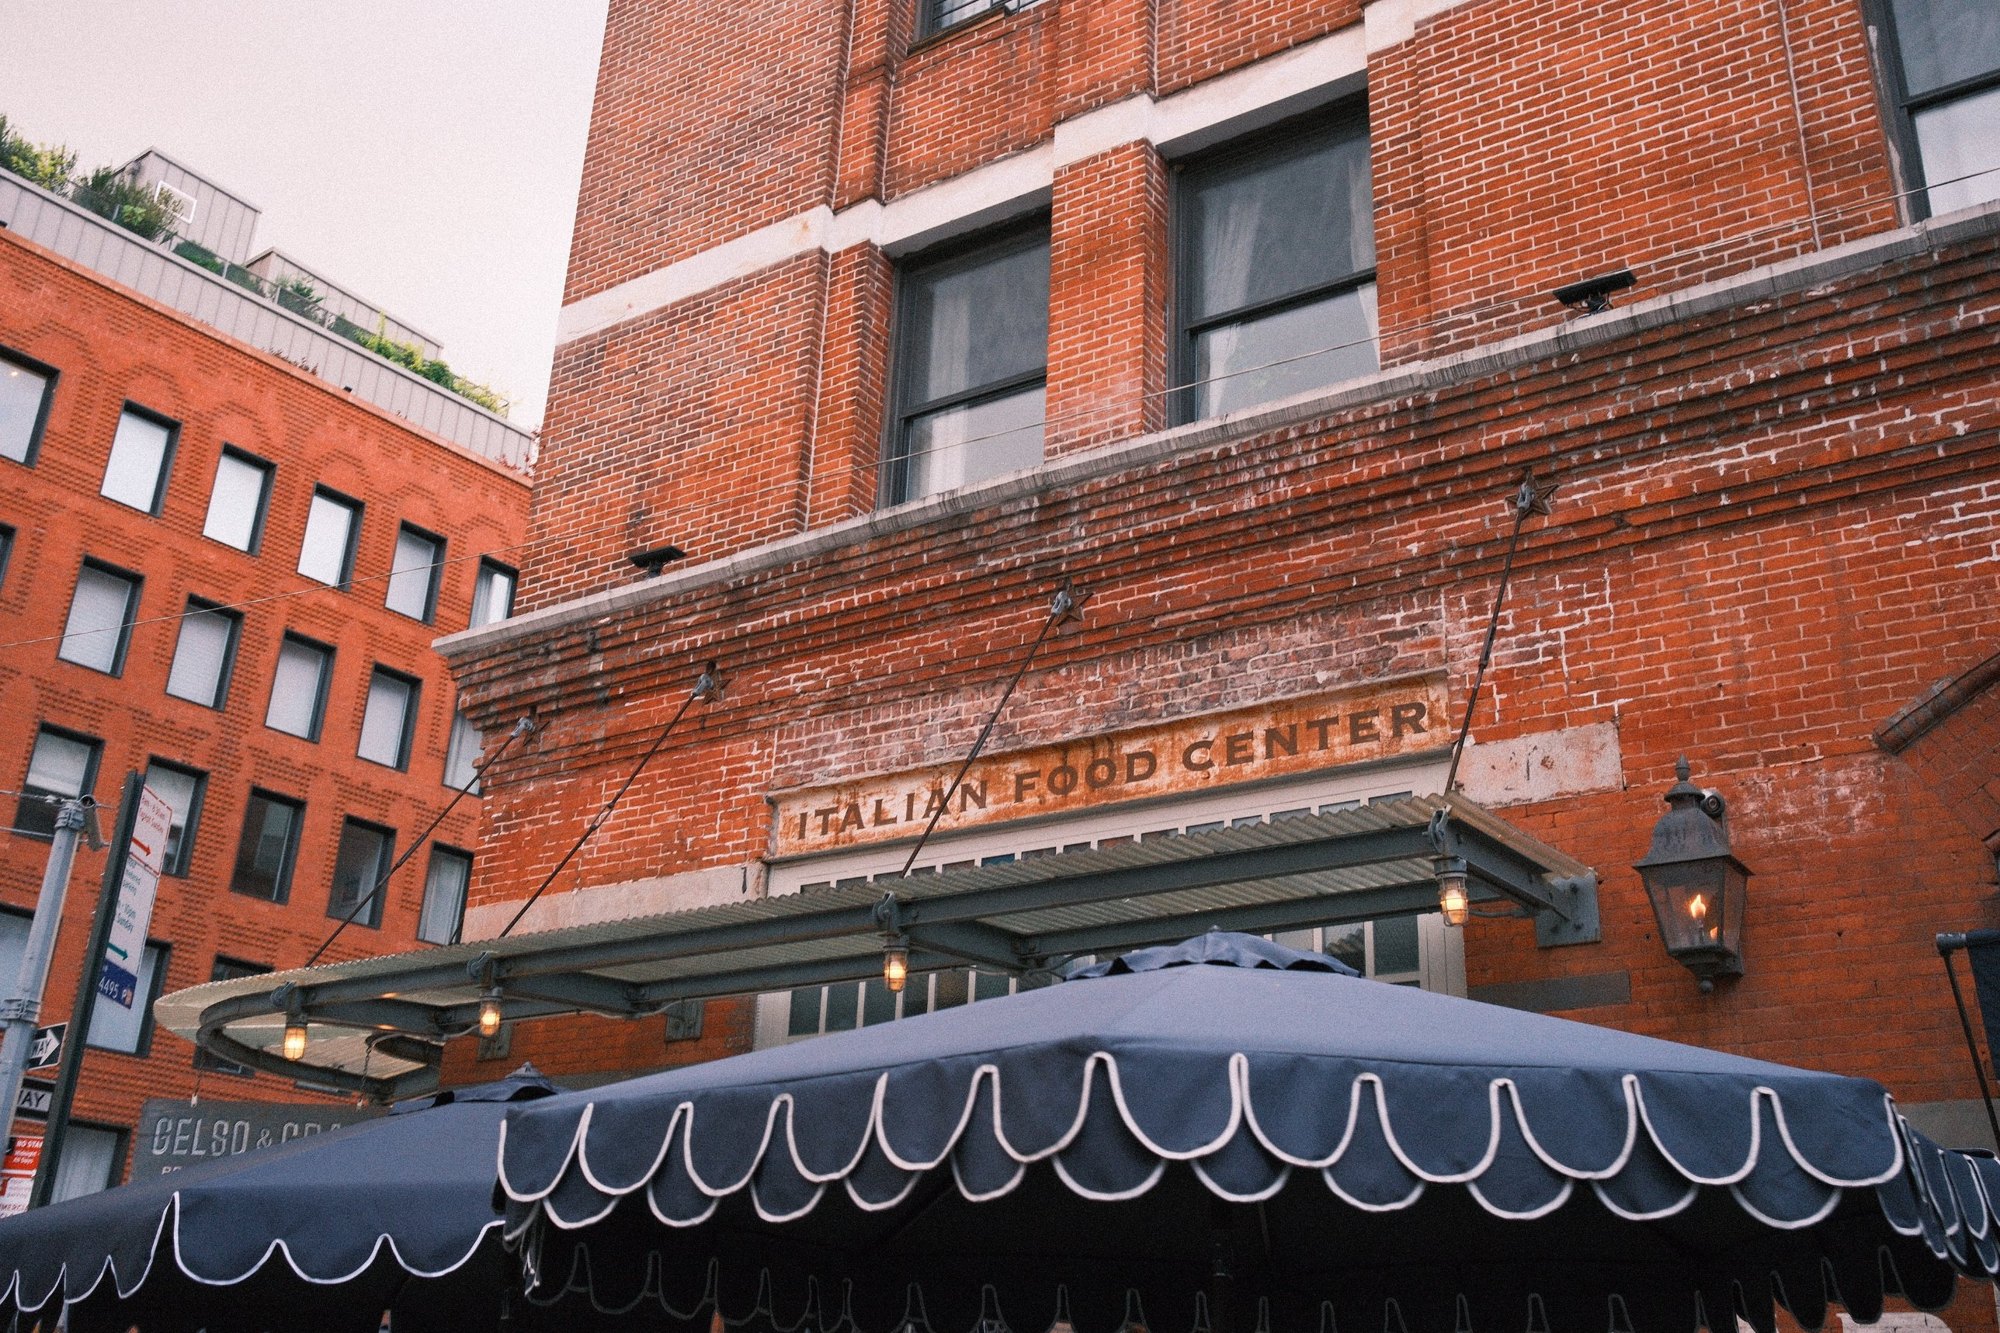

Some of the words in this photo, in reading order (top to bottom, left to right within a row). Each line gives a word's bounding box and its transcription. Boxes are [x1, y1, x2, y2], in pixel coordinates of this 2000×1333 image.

[797, 779, 988, 841] ITALIAN
[1014, 748, 1158, 804] FOOD
[1181, 700, 1429, 772] CENTER
[98, 976, 120, 999] 4495
[17, 1089, 45, 1108] AY
